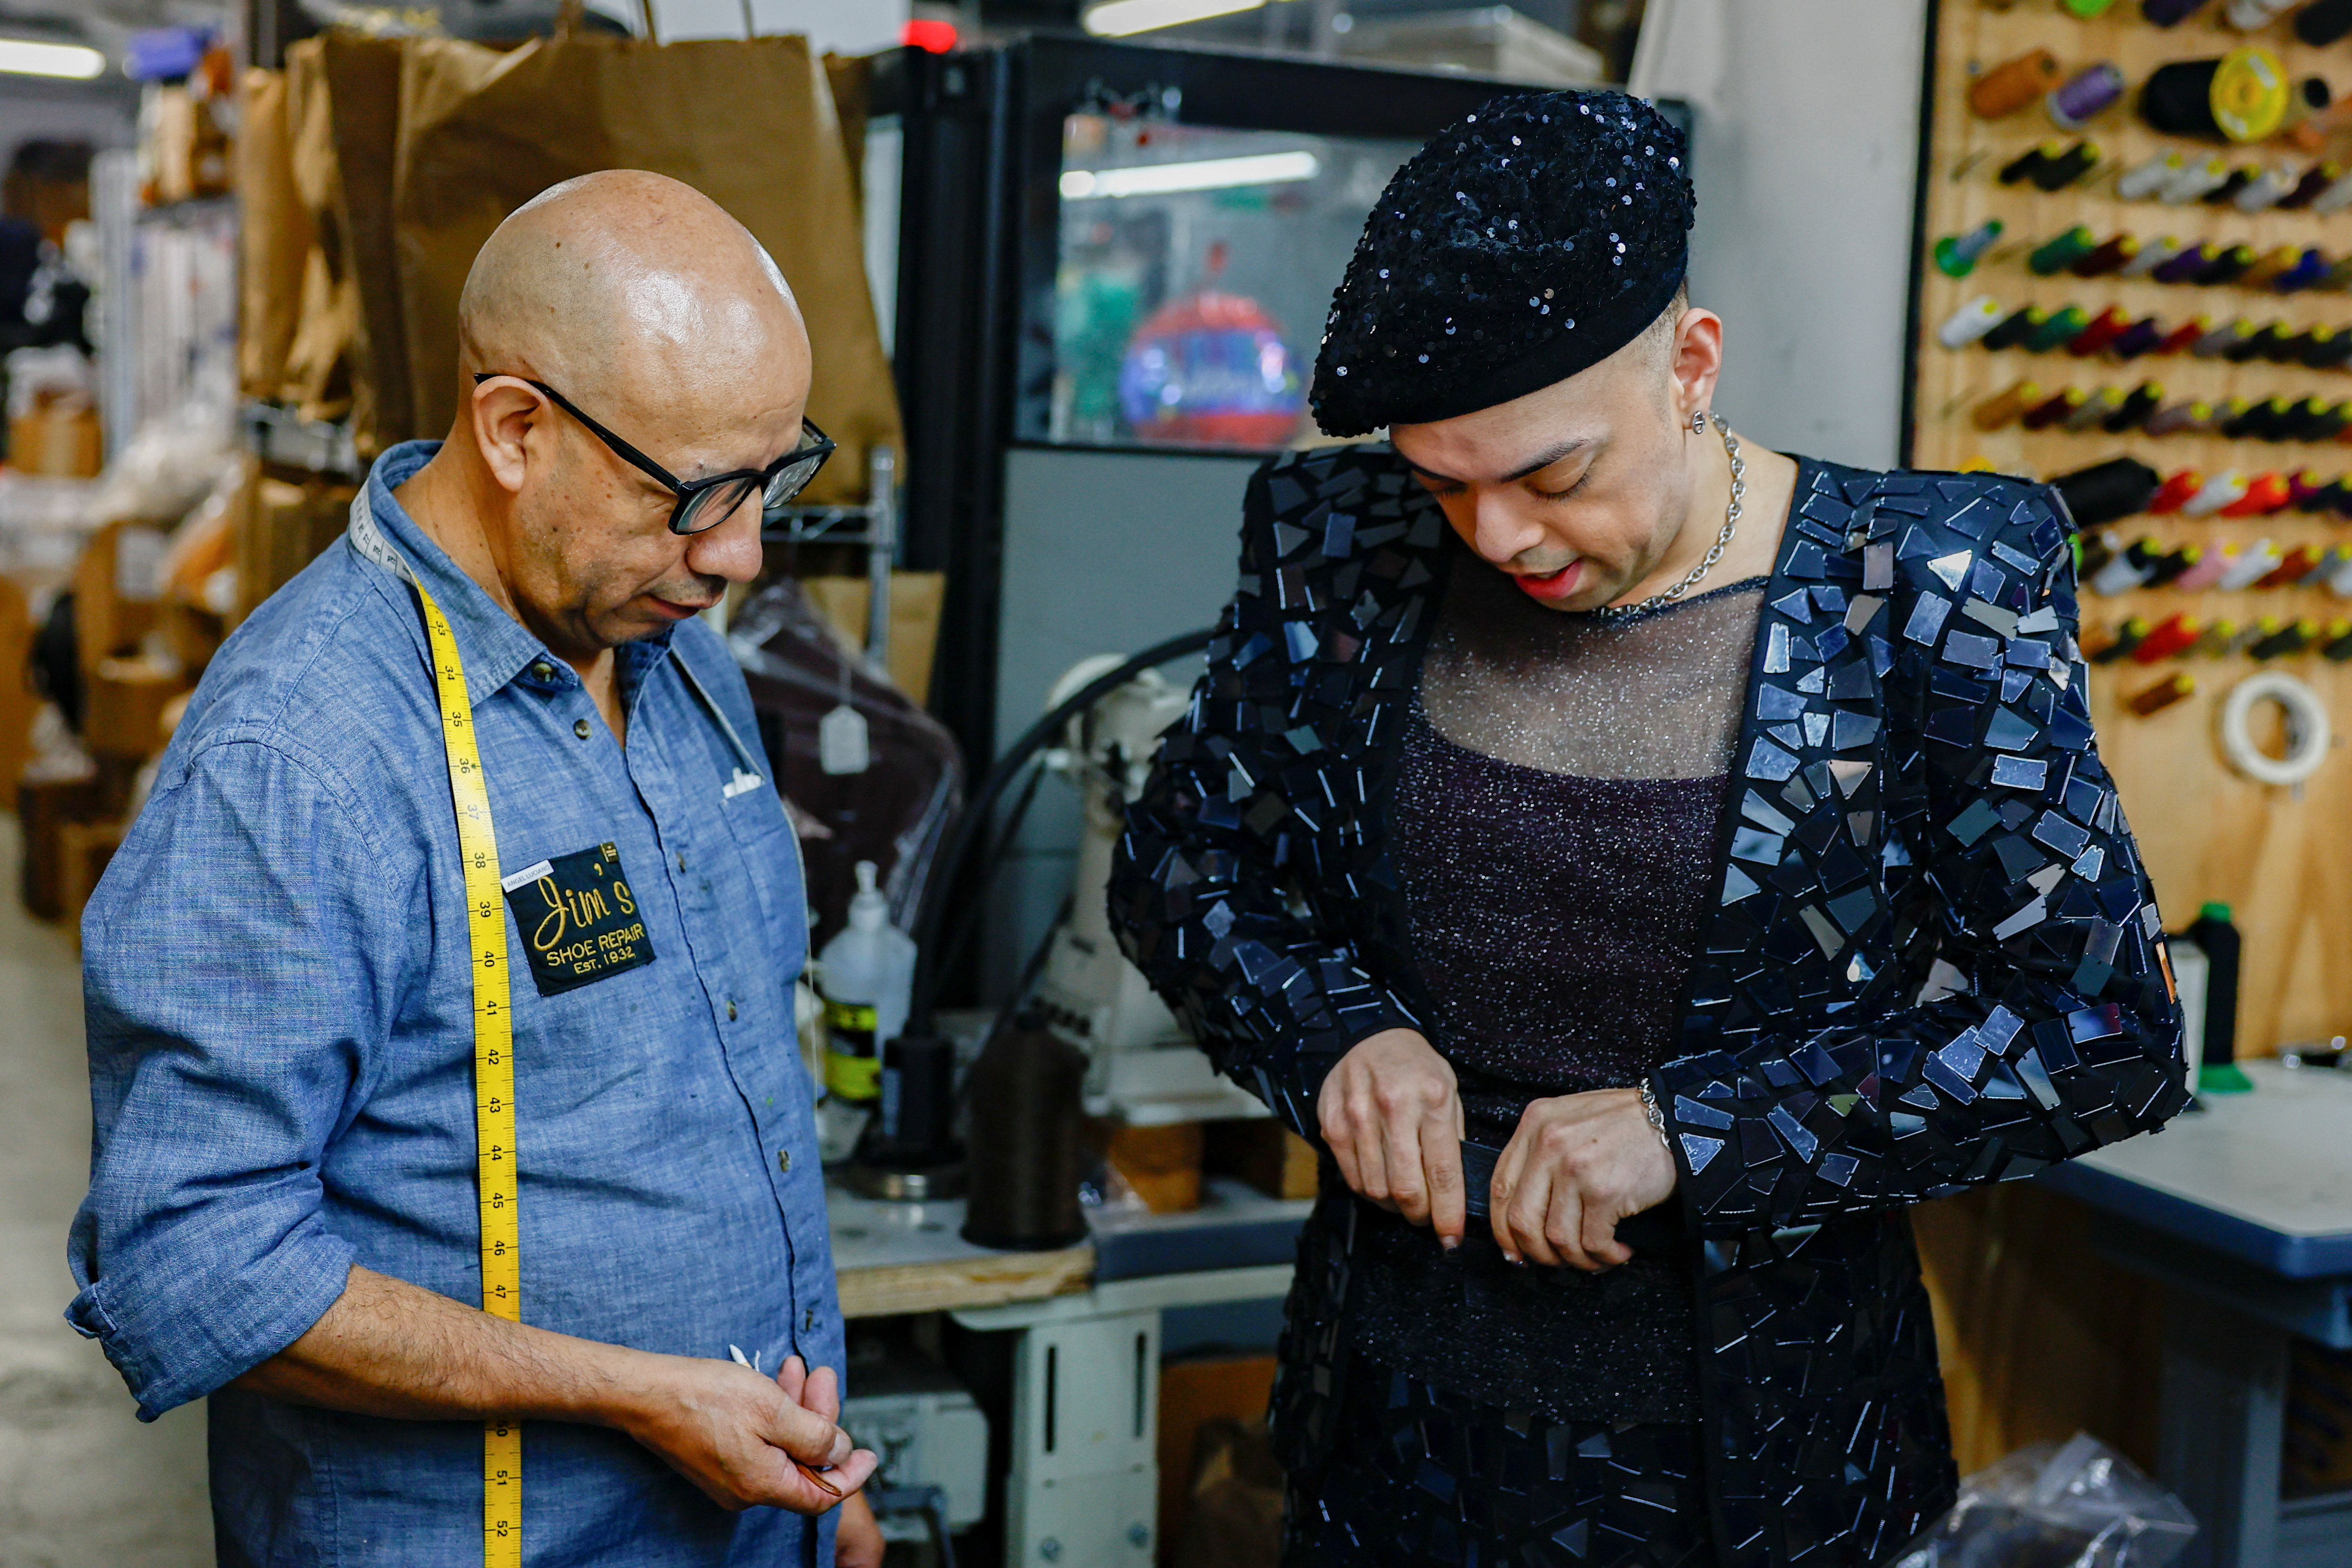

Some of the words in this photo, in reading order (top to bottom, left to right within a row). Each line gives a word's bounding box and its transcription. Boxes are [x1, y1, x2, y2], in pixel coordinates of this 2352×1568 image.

[436, 620, 446, 636] 33
[445, 665, 455, 681] 34
[452, 711, 463, 727] 35
[459, 758, 470, 773] 36
[467, 804, 479, 820] 37
[474, 852, 486, 869] 38
[507, 876, 525, 887] ANGEL
[526, 865, 550, 879] LUCIANO
[480, 901, 491, 918] 39
[534, 863, 635, 951] Jim's
[546, 939, 596, 966] SHOE
[598, 923, 645, 952] REPAIR
[484, 951, 495, 967] 40
[574, 959, 602, 974] EST.
[604, 946, 636, 965] 1932
[487, 1000, 497, 1016] 41
[489, 1049, 499, 1065] 42
[490, 1097, 500, 1113] 43
[491, 1145, 502, 1161] 44
[493, 1192, 503, 1208] 45
[494, 1241, 505, 1256] 46
[495, 1284, 506, 1299] 47
[497, 1470, 508, 1485] 51
[497, 1521, 508, 1537] 52
